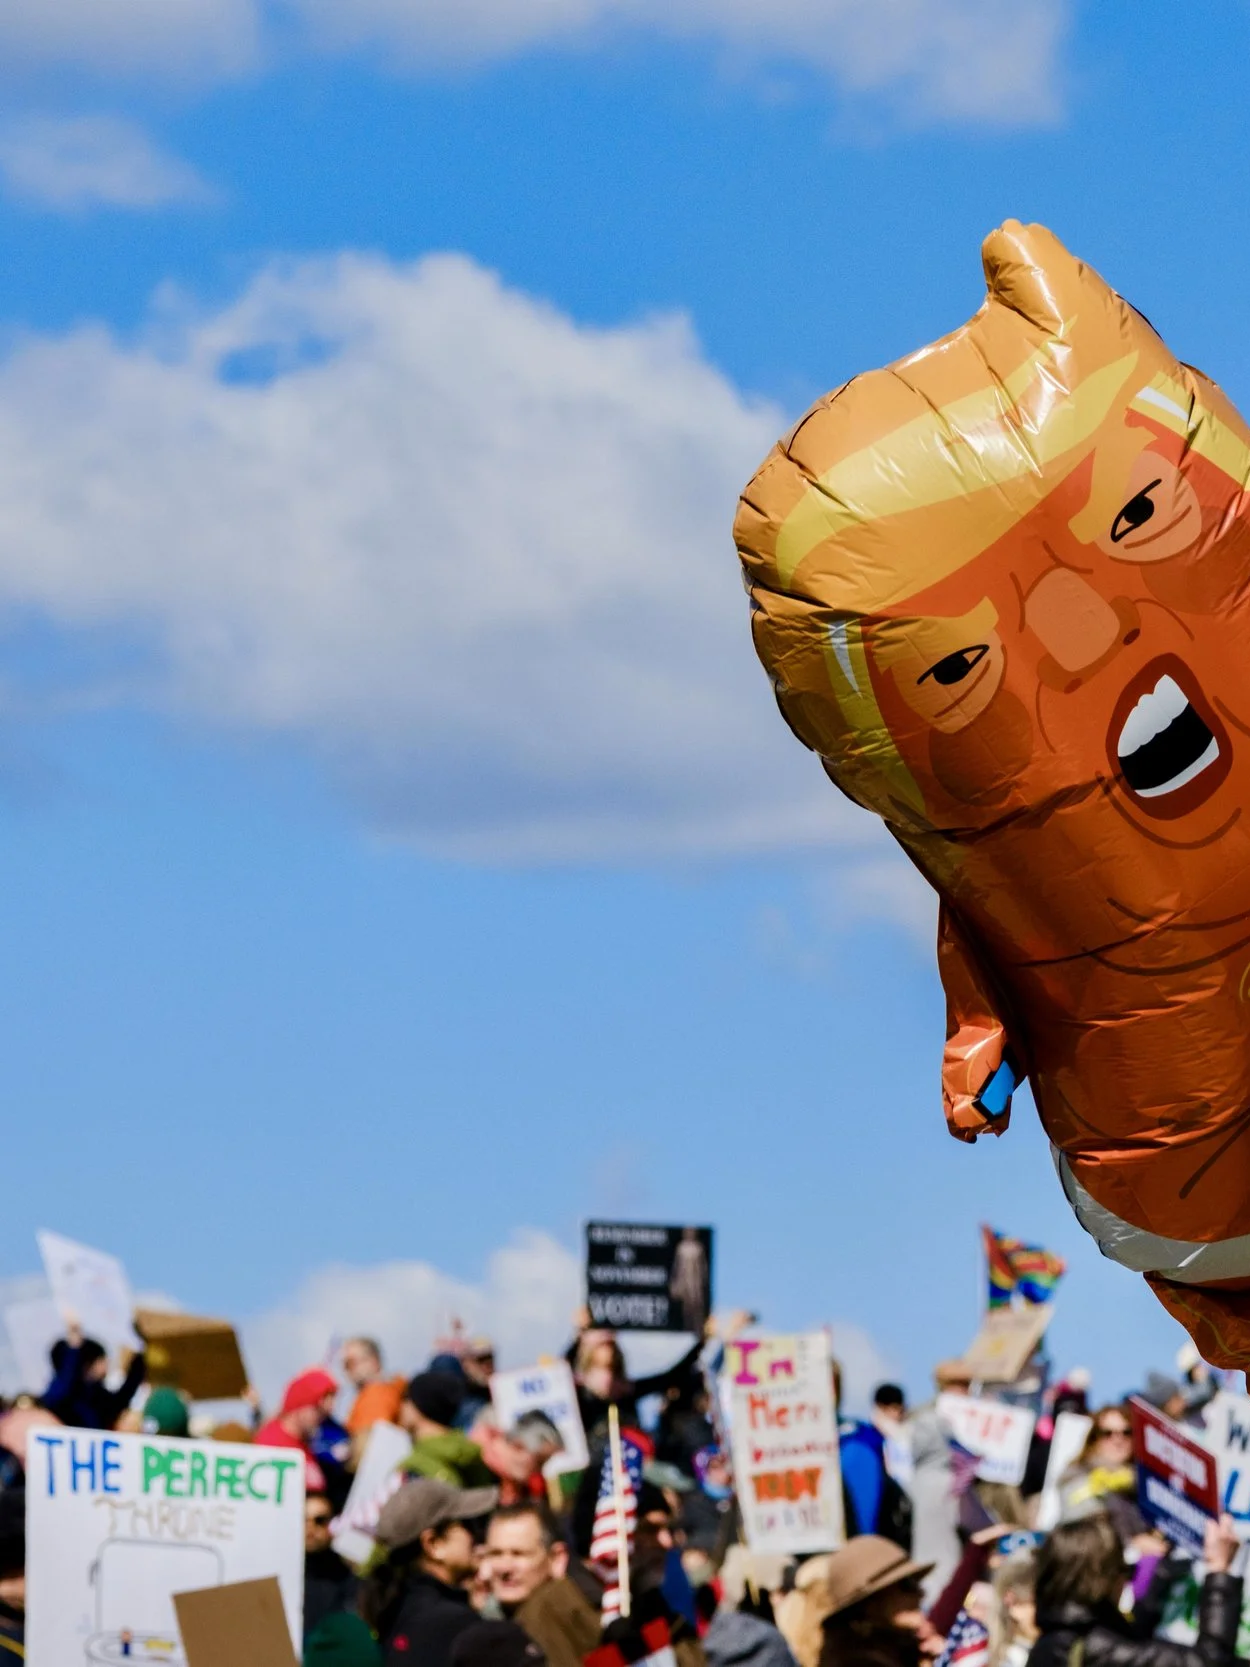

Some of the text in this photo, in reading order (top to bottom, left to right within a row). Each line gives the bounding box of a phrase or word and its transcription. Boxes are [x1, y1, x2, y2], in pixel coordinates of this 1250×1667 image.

[36, 1436, 297, 1505] THE PERFECT
[94, 1498, 236, 1541] THRONE
